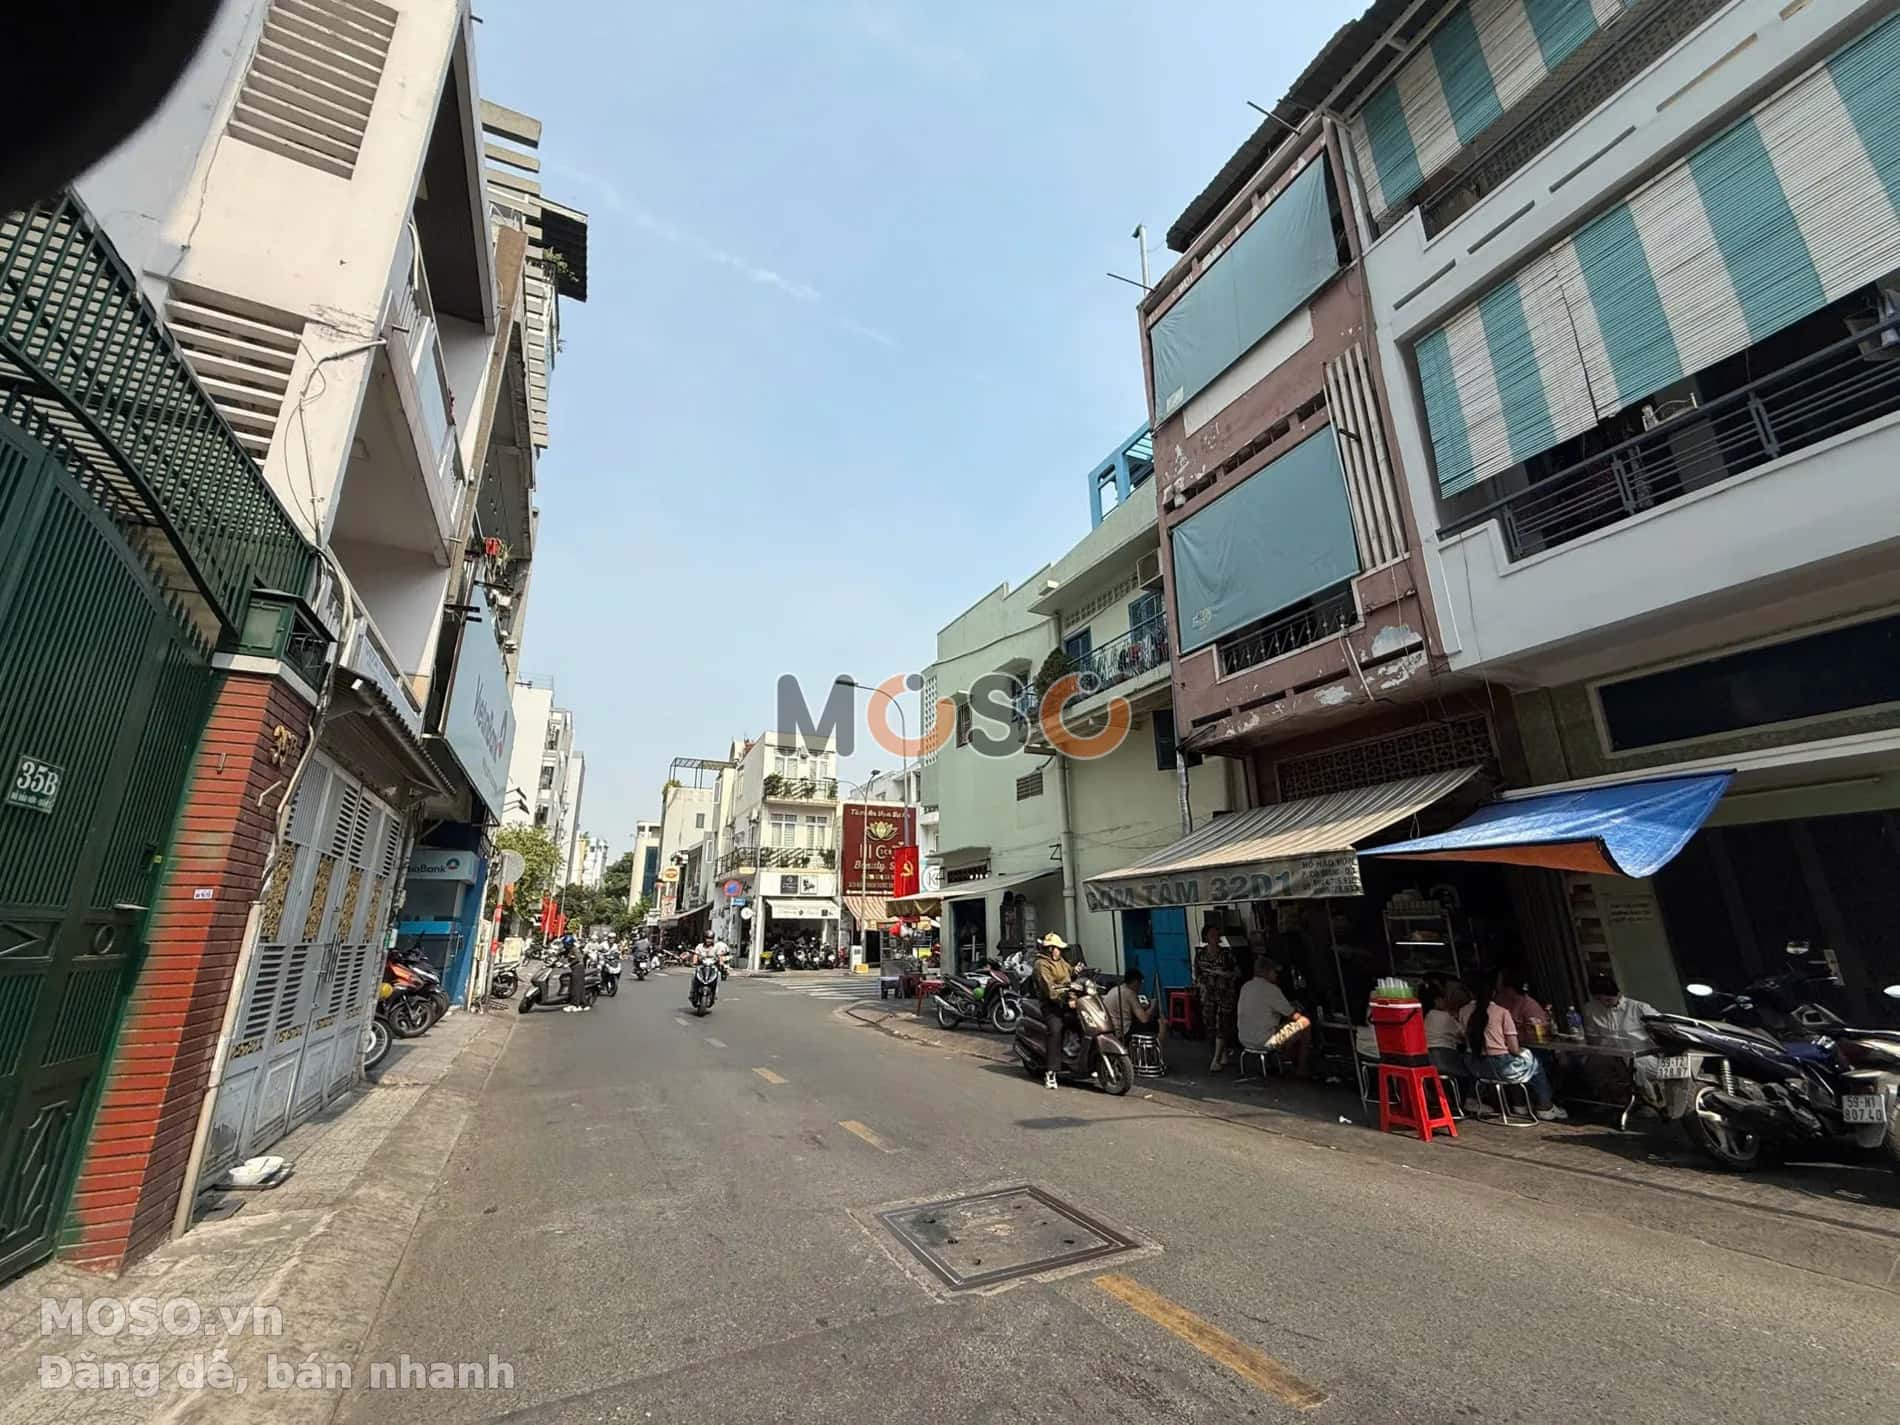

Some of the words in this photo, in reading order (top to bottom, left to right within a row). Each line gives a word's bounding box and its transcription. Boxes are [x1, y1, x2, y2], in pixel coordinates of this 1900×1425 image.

[17, 761, 58, 796] 35B
[1210, 872, 1290, 899] 32D1
[1847, 1096, 1875, 1108] 59-N1
[1845, 1108, 1882, 1121] 807.40
